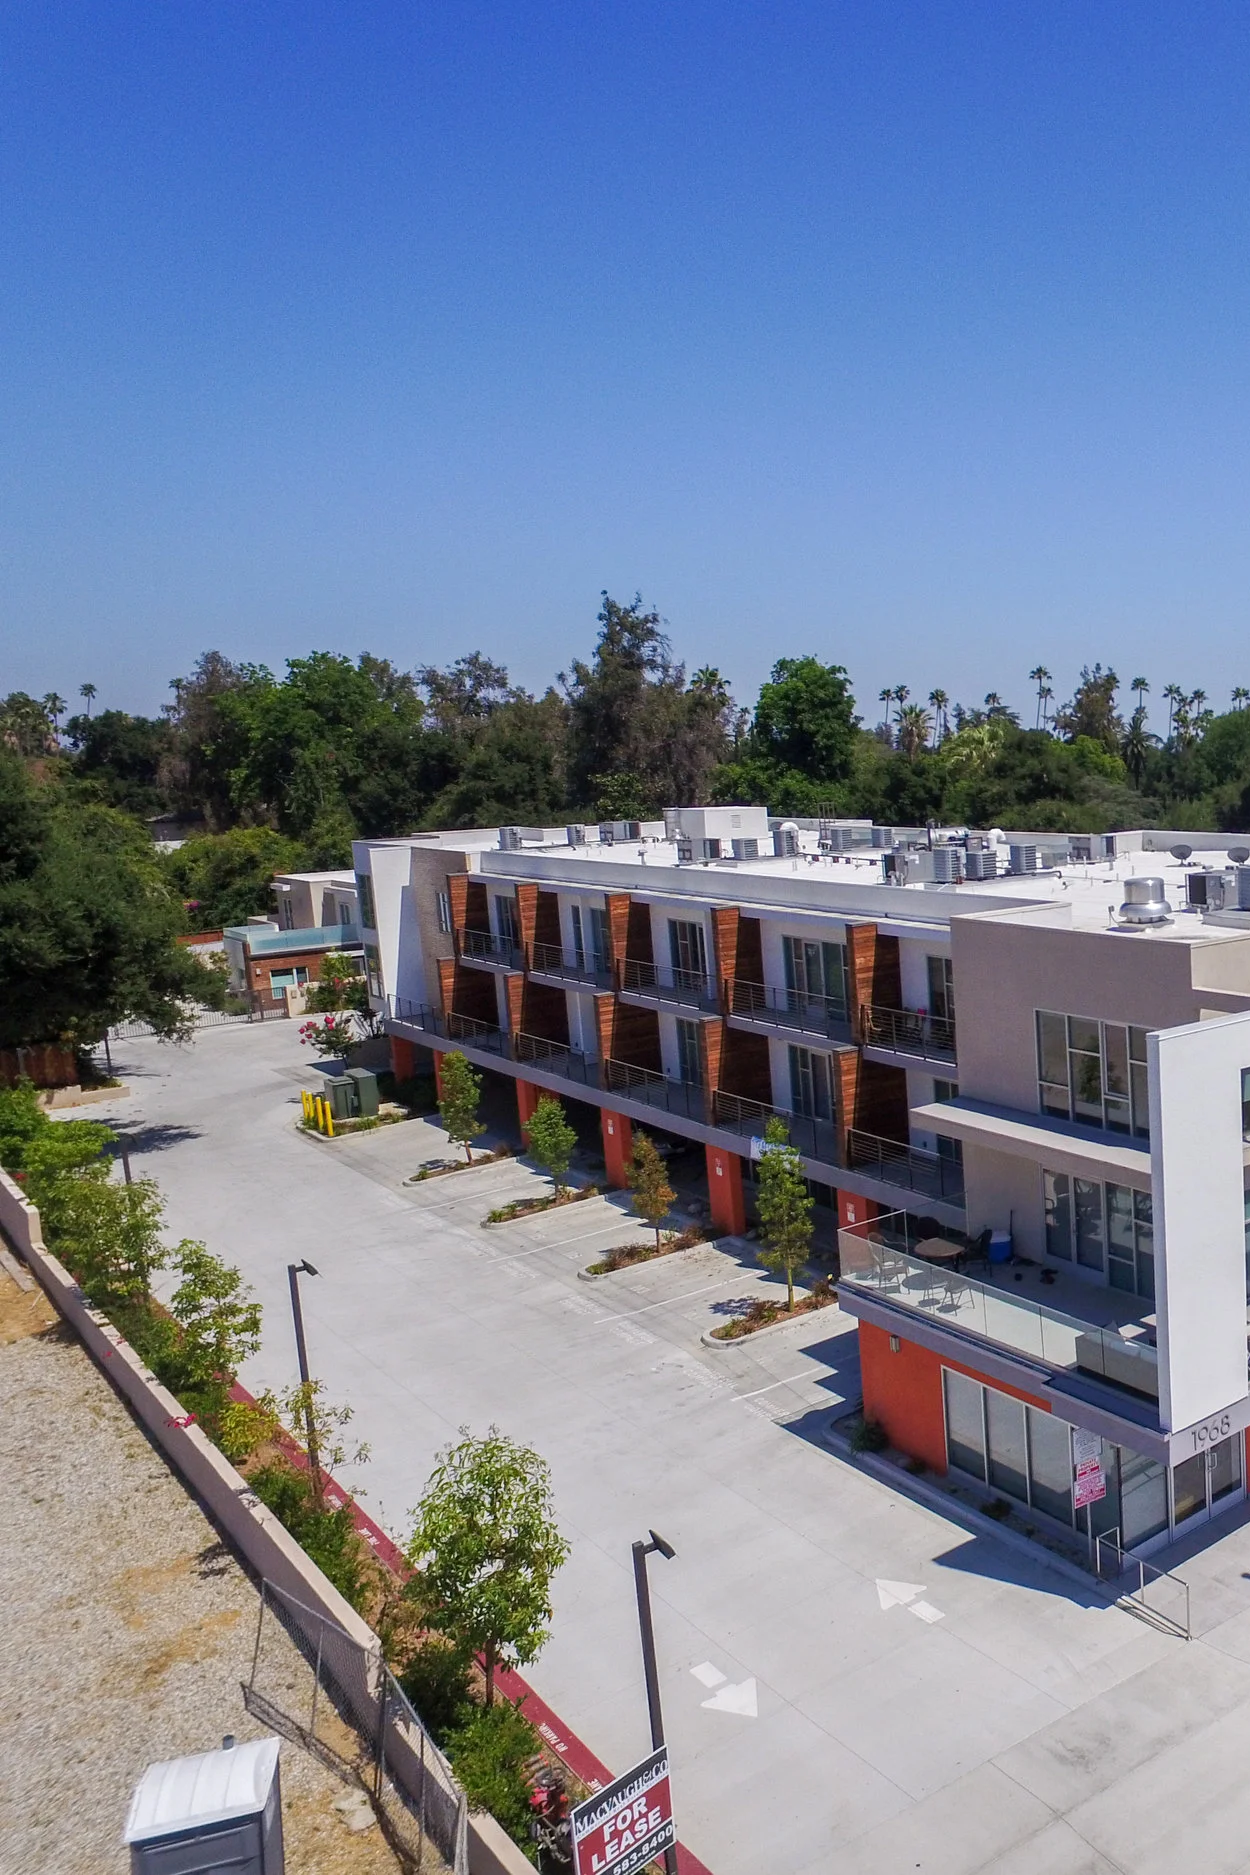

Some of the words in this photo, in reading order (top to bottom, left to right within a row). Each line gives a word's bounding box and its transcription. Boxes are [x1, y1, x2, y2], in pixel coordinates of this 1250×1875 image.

[1192, 1415, 1230, 1451] 1968
[592, 1806, 661, 1872] LEASE
[603, 1797, 648, 1843] FOR
